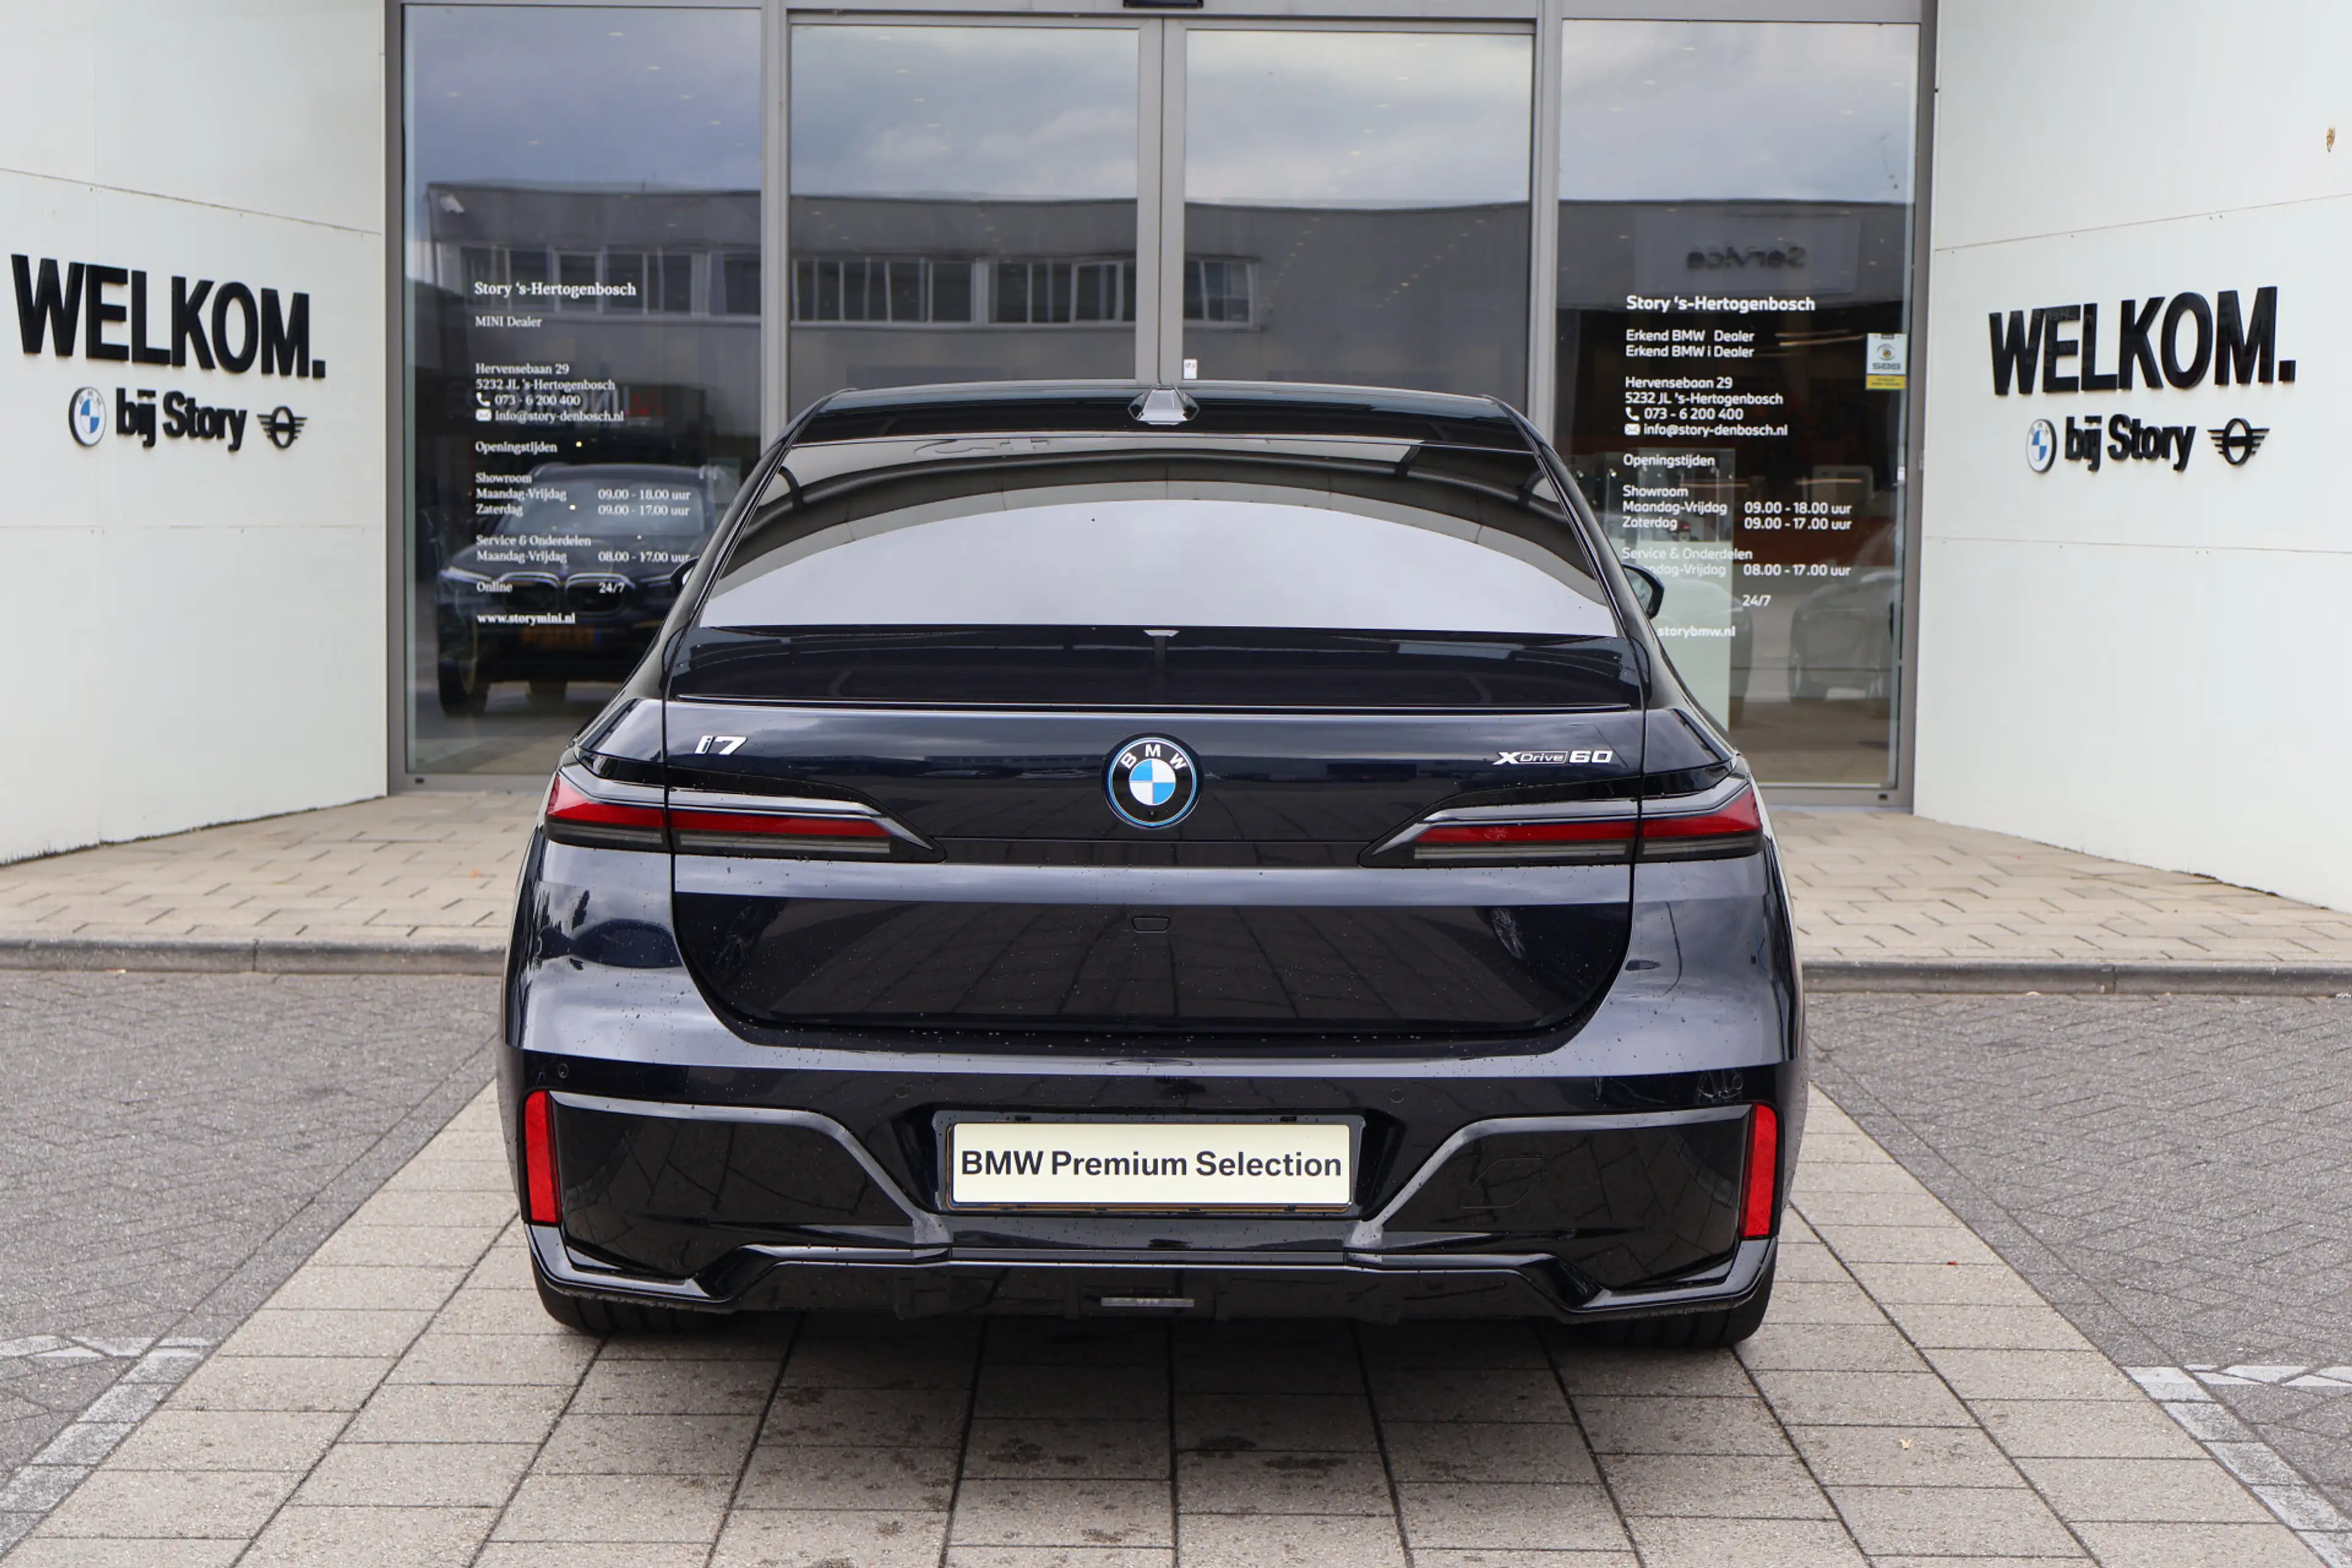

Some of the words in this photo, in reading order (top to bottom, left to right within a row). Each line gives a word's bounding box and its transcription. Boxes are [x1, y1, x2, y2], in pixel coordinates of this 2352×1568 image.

[474, 281, 513, 299] Story
[1626, 295, 1672, 314] Story
[11, 254, 326, 379] WELKOM.
[475, 315, 503, 327] MINI
[507, 315, 543, 327] Dealer
[1626, 329, 1670, 342] Erkend
[1672, 329, 1706, 342] BMW
[1714, 329, 1755, 342] Dealer
[1989, 286, 2297, 396] WELKOM.
[1626, 345, 1669, 358] Erkend
[1672, 345, 1705, 358] BMW
[1707, 345, 1711, 358] i
[1713, 345, 1755, 358] Dealer
[475, 362, 552, 375] Hervensebaan
[555, 362, 570, 375] 29
[475, 378, 503, 390] 5232
[505, 378, 520, 390] JL
[1625, 376, 1714, 389] Hervensebaan
[1716, 376, 1733, 389] 29
[494, 394, 516, 407] 073
[526, 394, 533, 407] 6
[535, 394, 557, 407] 200
[559, 394, 581, 407] 400
[1624, 391, 1656, 404] 5232
[1657, 391, 1672, 405] JL
[116, 387, 156, 448] bij
[162, 390, 247, 451] Story
[494, 409, 625, 424] info@story-denbosch.nl
[1643, 407, 1668, 420] 073
[1679, 407, 1688, 420] 6
[1689, 407, 1716, 420] 200
[1717, 407, 1744, 421] 400
[1643, 423, 1789, 439] info@story-denbosch.nl
[475, 440, 558, 455] Openingstijden
[2065, 415, 2103, 472] bij
[2107, 414, 2196, 472] Story
[1623, 453, 1715, 468] Openingstijden
[475, 472, 532, 483] Showroom
[476, 488, 567, 502] Maandag-Vrijdag
[598, 488, 630, 501] 09.00
[639, 488, 669, 501] 18.00
[672, 491, 691, 501] uur
[1623, 484, 1689, 498] Showroom
[475, 503, 523, 518] Zaterdag
[598, 504, 630, 516] 09.00
[639, 504, 669, 516] 17.00
[671, 507, 690, 516] uur
[1623, 500, 1728, 516] Maandag-Vrijdag
[1744, 501, 1782, 514] 09.00
[1793, 501, 1829, 514] 18.00
[1831, 504, 1852, 515] uur
[1622, 516, 1678, 532] Zaterdag
[1744, 517, 1782, 530] 09.00
[1793, 517, 1829, 530] 17.00
[1831, 519, 1852, 530] uur
[475, 535, 517, 546] Service
[529, 535, 592, 546] Onderdelen
[477, 550, 567, 565] Maandag-Vrijdag
[598, 551, 630, 562] 08.00
[640, 551, 669, 563] 17.00
[671, 554, 690, 563] uur
[1622, 548, 1667, 560] Service
[1669, 548, 1679, 560] &
[1683, 548, 1754, 560] Onderdelen
[1645, 564, 1727, 578] ndag-Vrijdag
[1743, 564, 1782, 576] 08.00
[1792, 564, 1828, 577] 17.00
[1830, 567, 1851, 577] uur
[476, 581, 513, 594] Online
[598, 582, 625, 594] 24/7
[1742, 594, 1771, 607] 24/7
[477, 612, 576, 627] www.storymini.nl
[1656, 625, 1736, 639] storybmw.nl
[1120, 744, 1187, 770] BMW
[962, 1150, 1044, 1175] BMW
[1052, 1151, 1187, 1175] Premium
[1196, 1151, 1342, 1176] Selection
